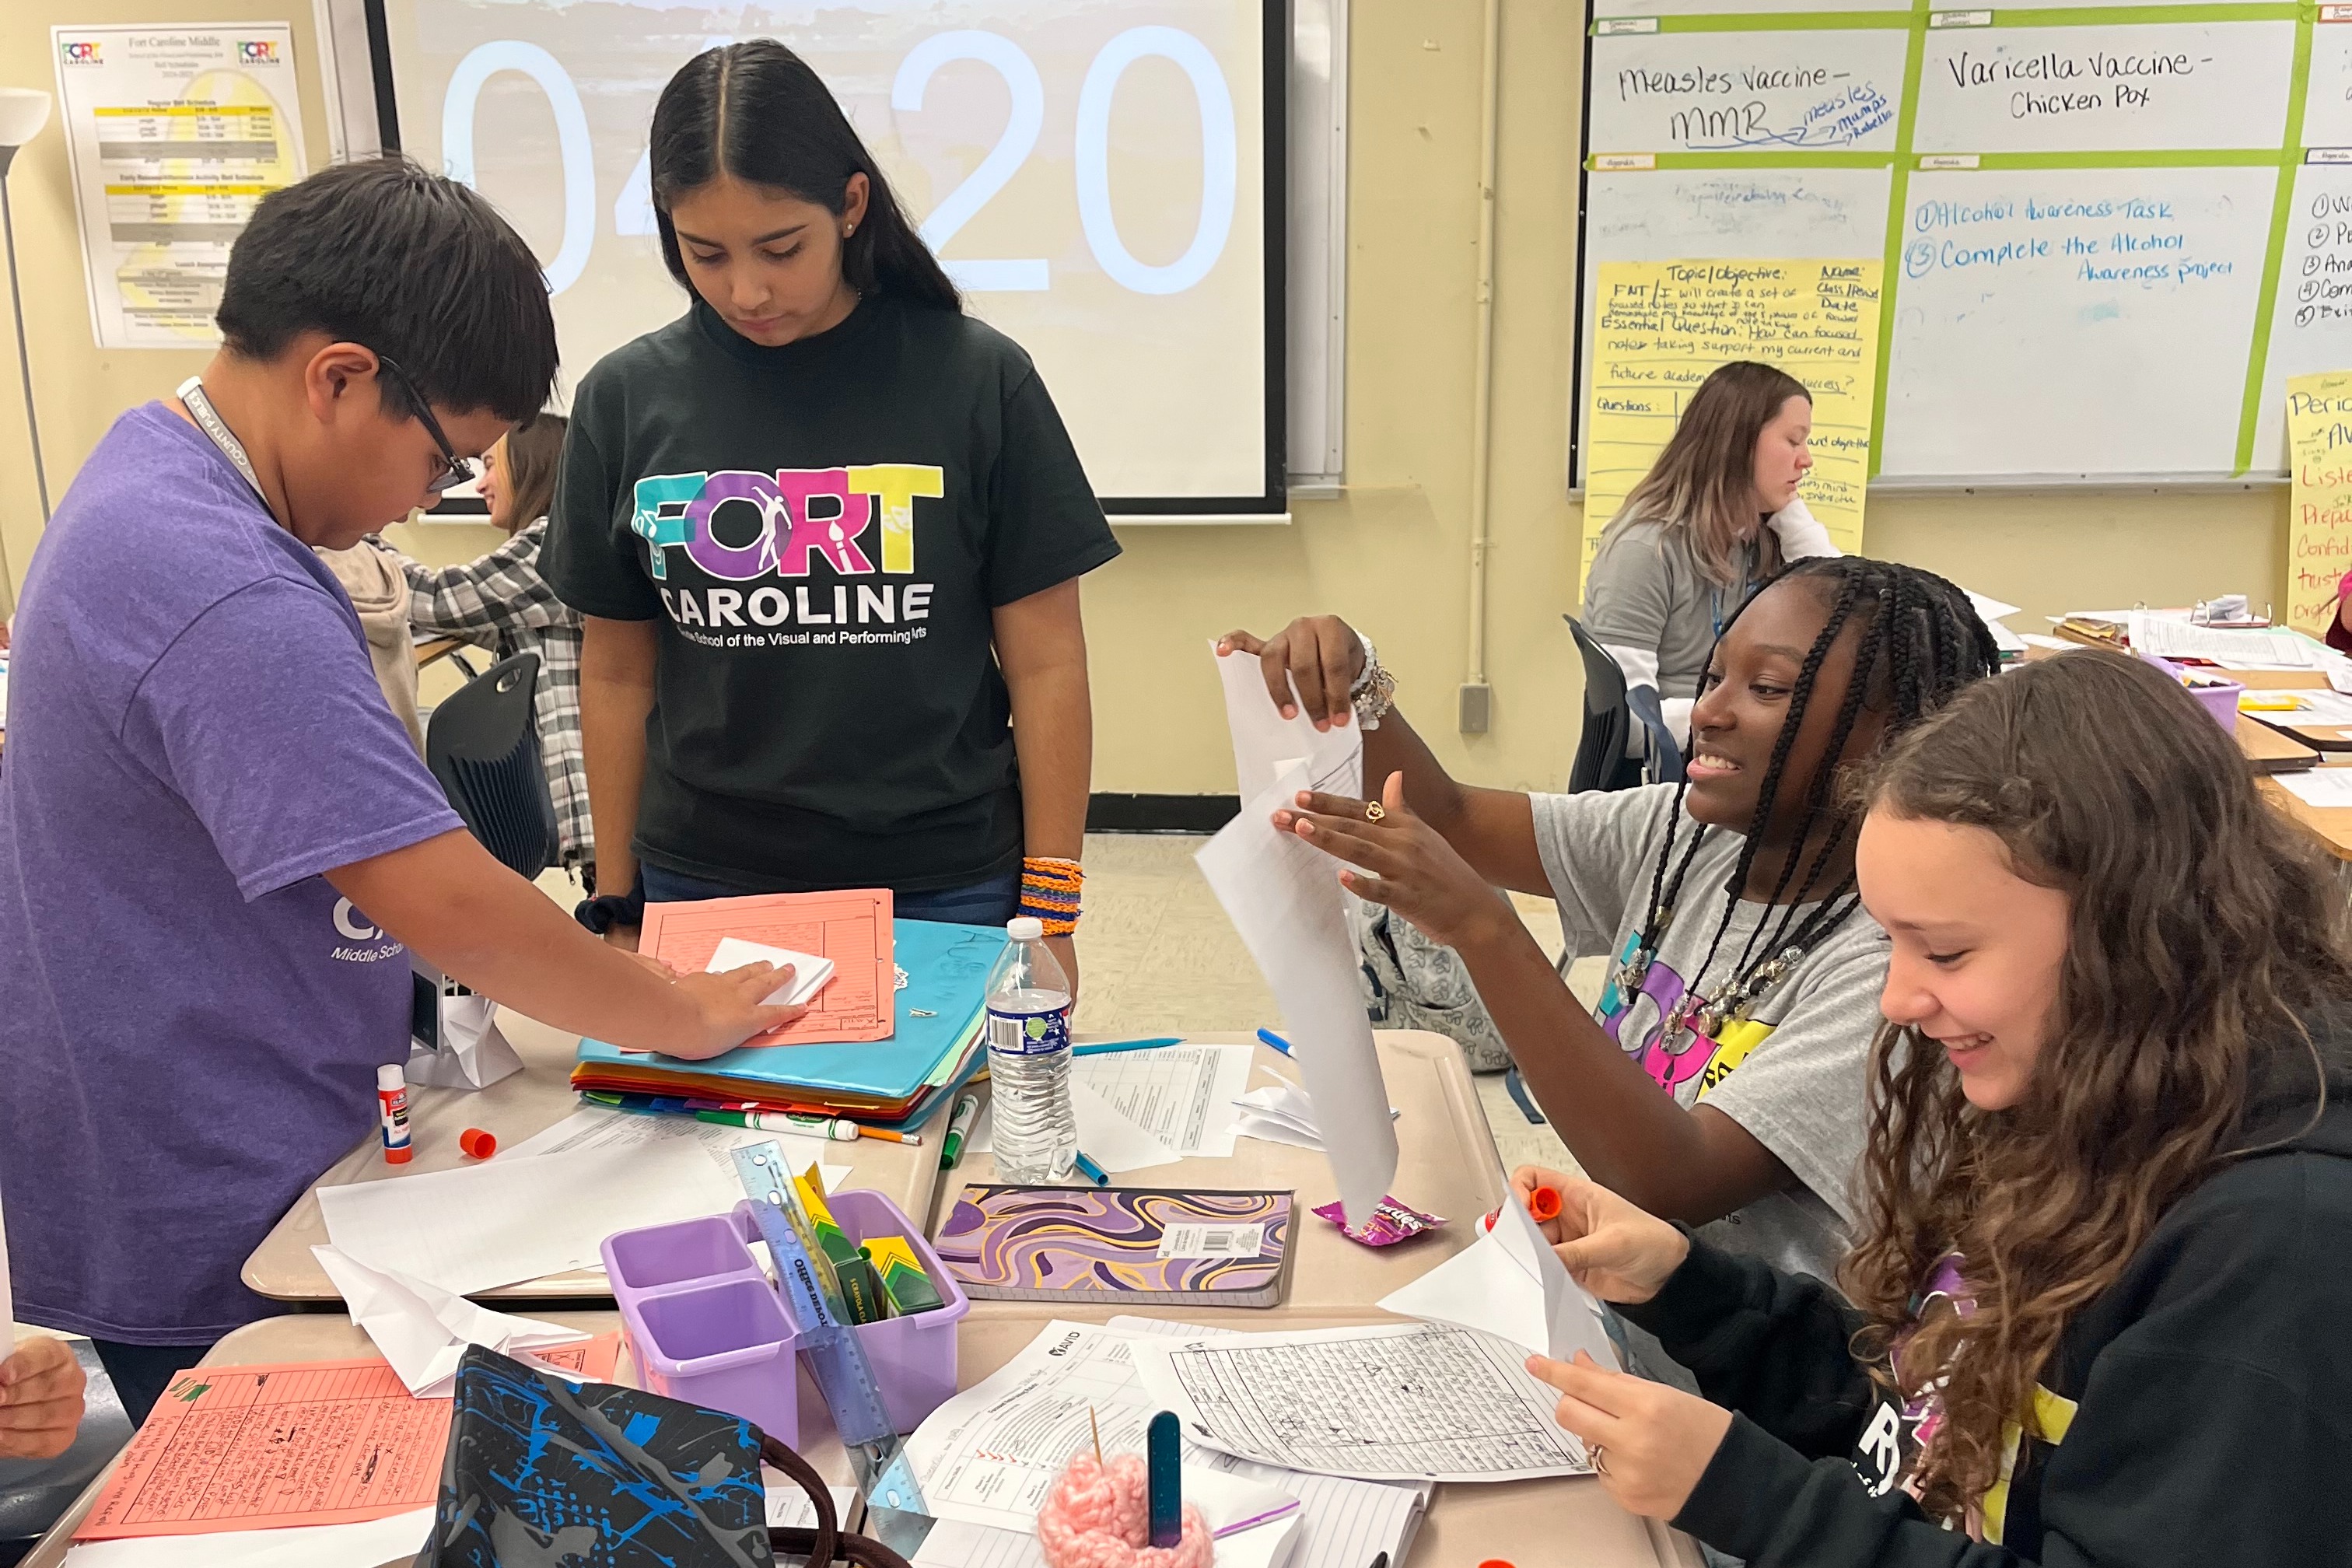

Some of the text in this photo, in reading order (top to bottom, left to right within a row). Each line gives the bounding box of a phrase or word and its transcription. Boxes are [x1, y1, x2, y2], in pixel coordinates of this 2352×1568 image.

[1948, 51, 2084, 88] Varicella
[2010, 85, 2150, 119] Chicken Pox
[1671, 101, 1769, 140] MMR
[890, 26, 1237, 296] 20
[2115, 199, 2173, 219] Task
[1941, 237, 2049, 270] Complete
[2063, 236, 2098, 256] the
[2111, 234, 2182, 253] Alcohol
[2077, 258, 2169, 282] Awareness
[1679, 287, 1702, 298] will
[1706, 289, 1741, 298] create
[1747, 289, 1755, 298] a
[1761, 286, 1778, 299] set
[1783, 289, 1797, 298] of
[1601, 316, 1664, 331] Essential
[1654, 337, 1695, 355] taking
[1702, 341, 1755, 357] support
[1762, 345, 1783, 358] my
[1788, 345, 1834, 357] current
[1838, 346, 1860, 358] and
[1611, 365, 1657, 380] future
[192, 399, 248, 466] COUNTY PUBLIC
[631, 464, 944, 582] FORT
[660, 583, 934, 627] CAROLINE
[726, 634, 740, 646] of
[744, 633, 765, 646] the
[768, 631, 810, 646] Visual
[813, 632, 836, 645] and
[839, 631, 911, 645] Performing
[911, 625, 927, 639] Arts
[331, 947, 378, 963] Middle
[1059, 1332, 1080, 1349] AVID
